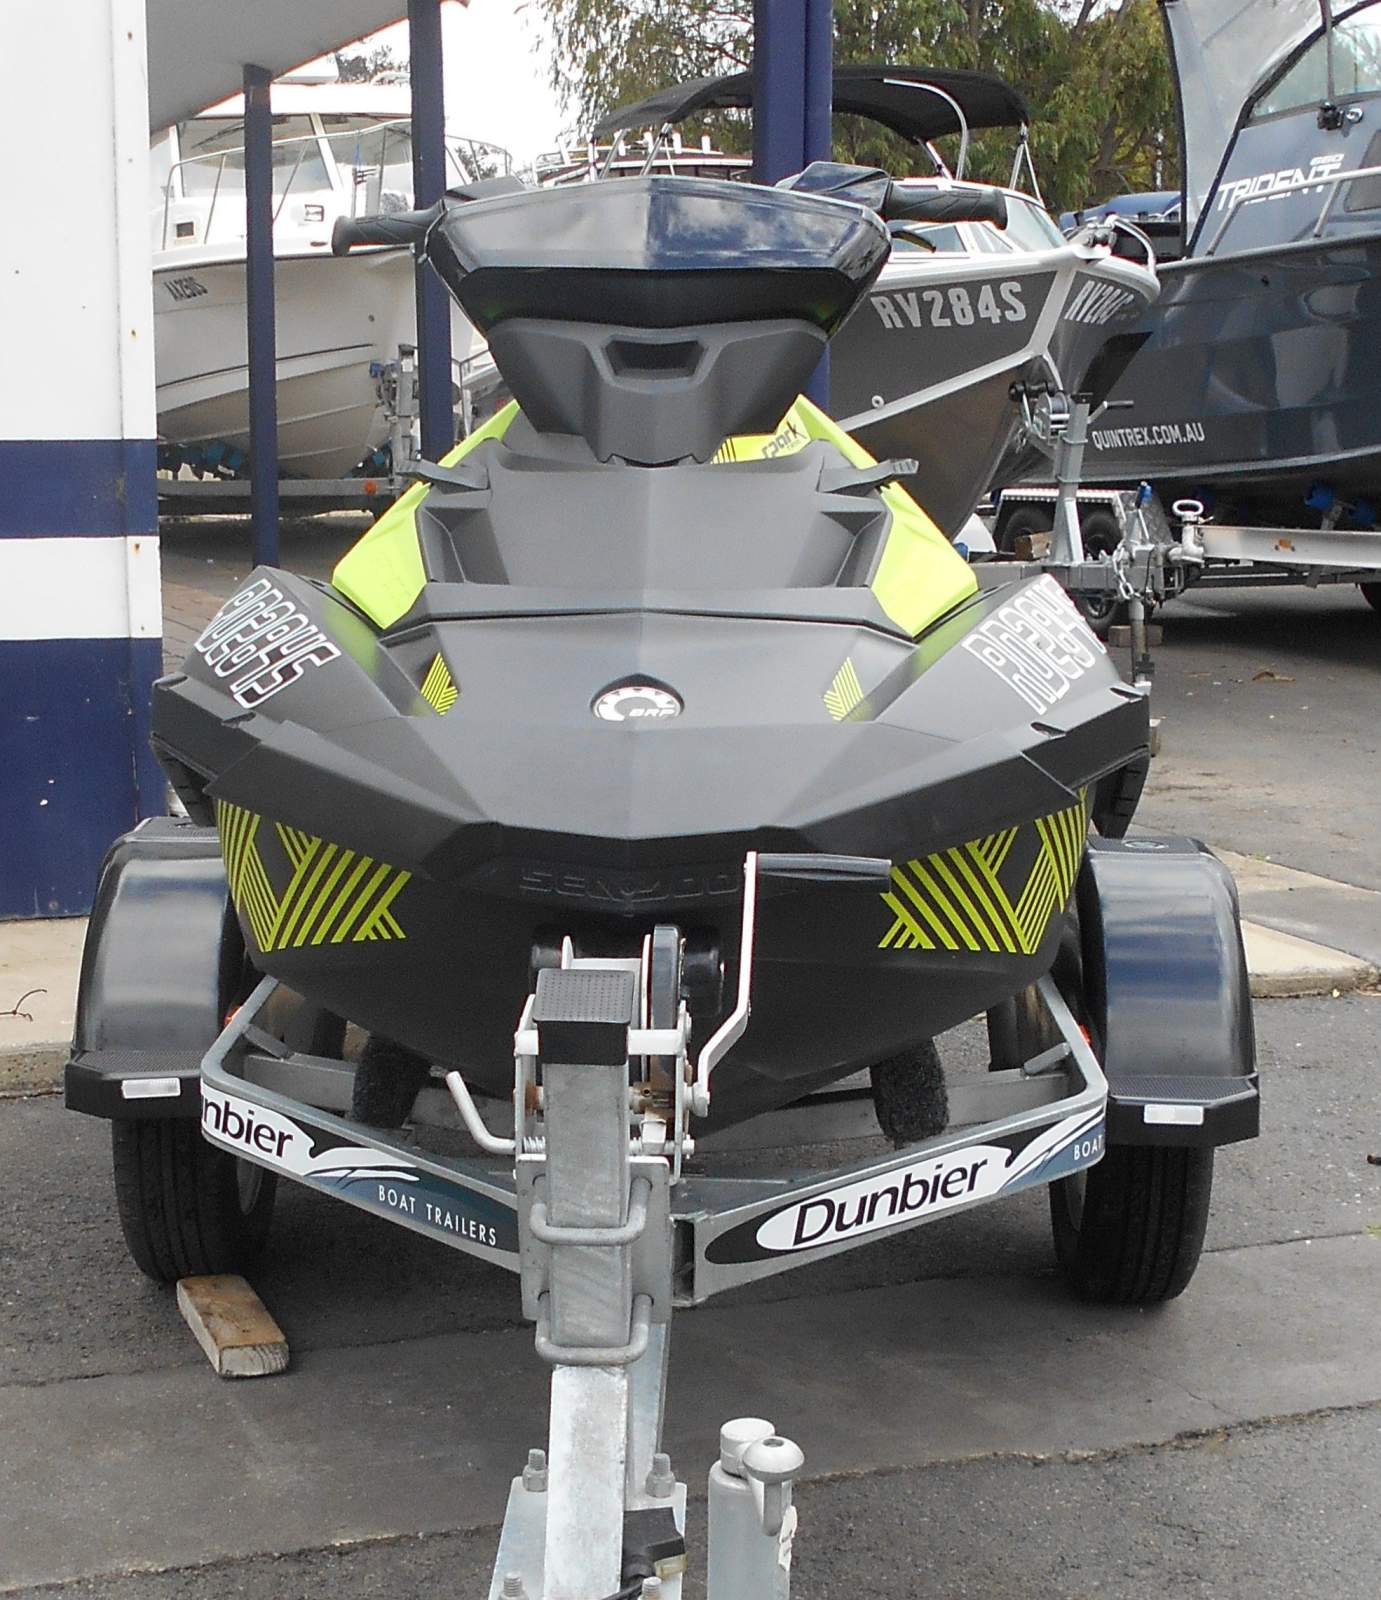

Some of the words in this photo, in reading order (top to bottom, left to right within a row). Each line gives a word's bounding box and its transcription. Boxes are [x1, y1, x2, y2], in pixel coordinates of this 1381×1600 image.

[1217, 163, 1342, 212] TRIDENT
[870, 281, 1027, 329] RV284S
[1092, 422, 1206, 451] QUINTREX.COM.AU
[203, 1097, 294, 1158] nbier
[378, 1184, 416, 1214] BOAT
[425, 1203, 498, 1247] TRAILERS
[792, 1158, 989, 1247] Dunbier
